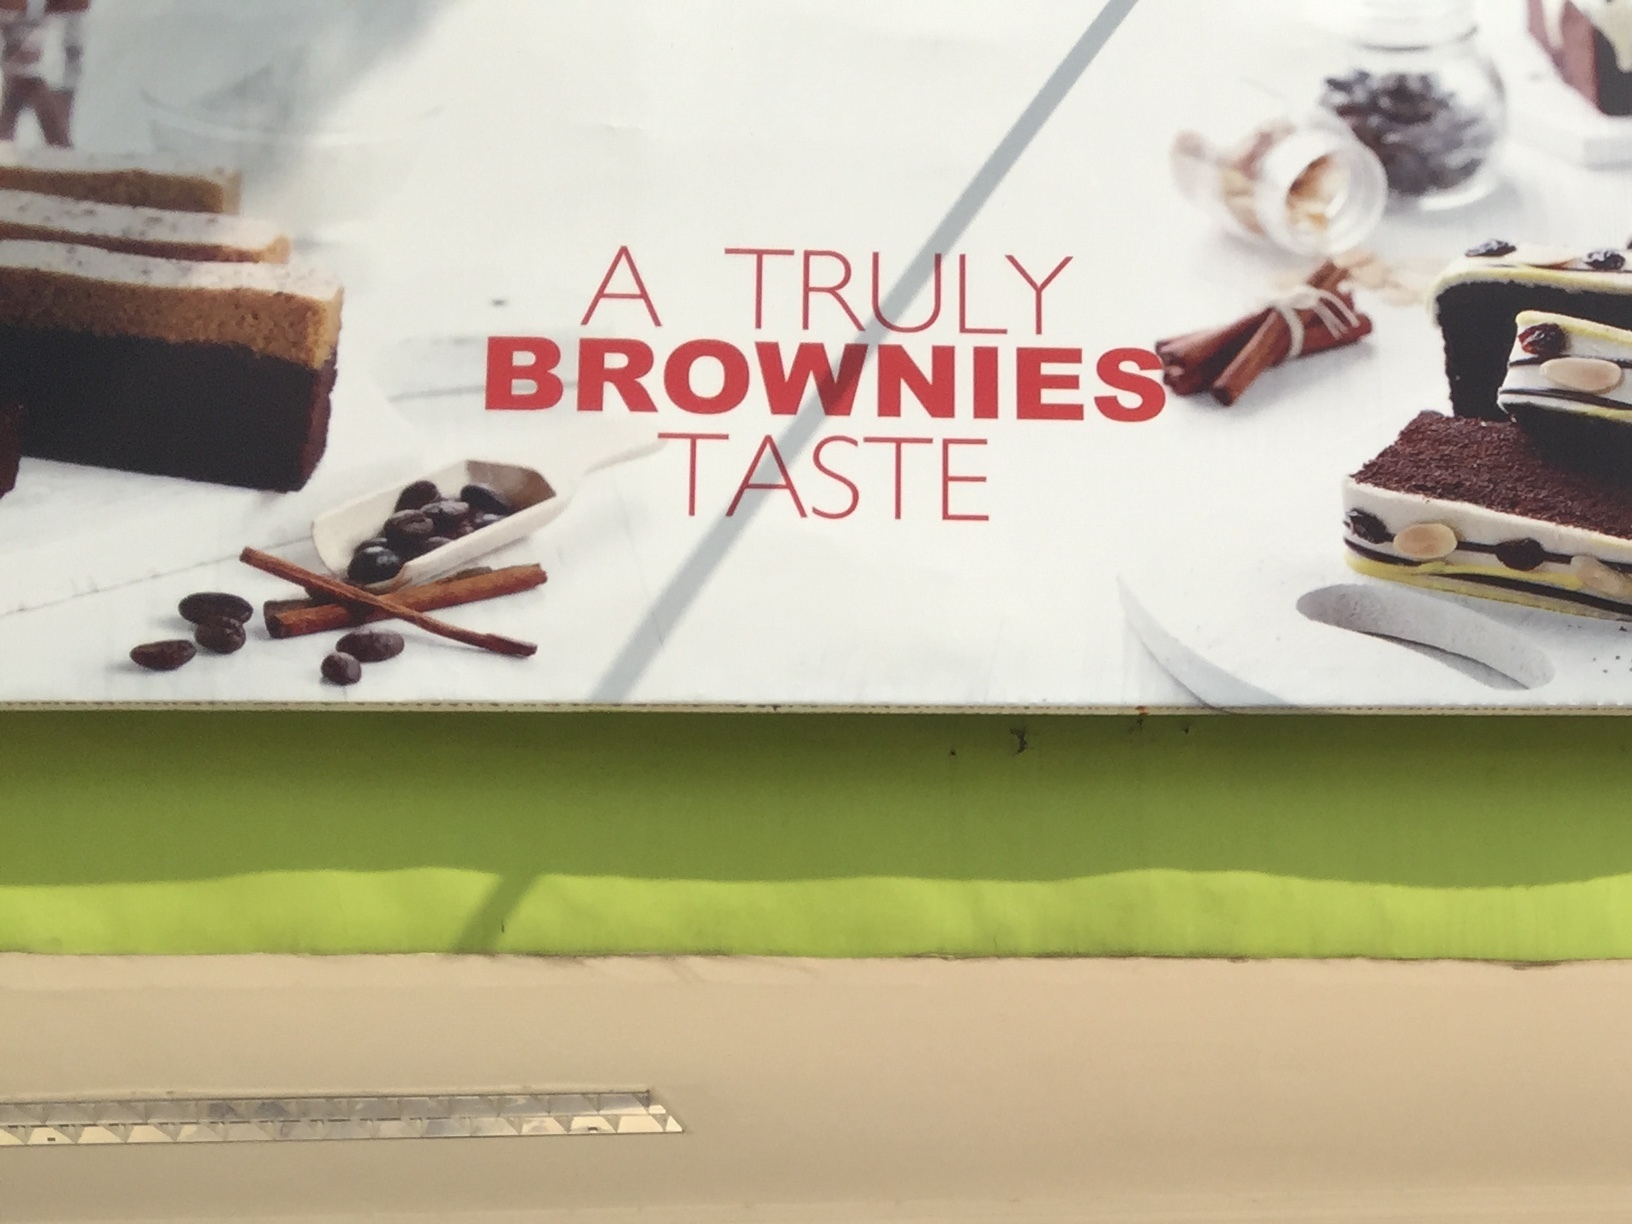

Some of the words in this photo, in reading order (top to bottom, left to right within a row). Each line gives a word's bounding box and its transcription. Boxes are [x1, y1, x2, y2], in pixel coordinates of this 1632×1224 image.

[581, 246, 662, 327] A
[725, 248, 1073, 335] TRULY
[484, 335, 1168, 422] BROWNIES
[657, 432, 989, 521] TASTE
